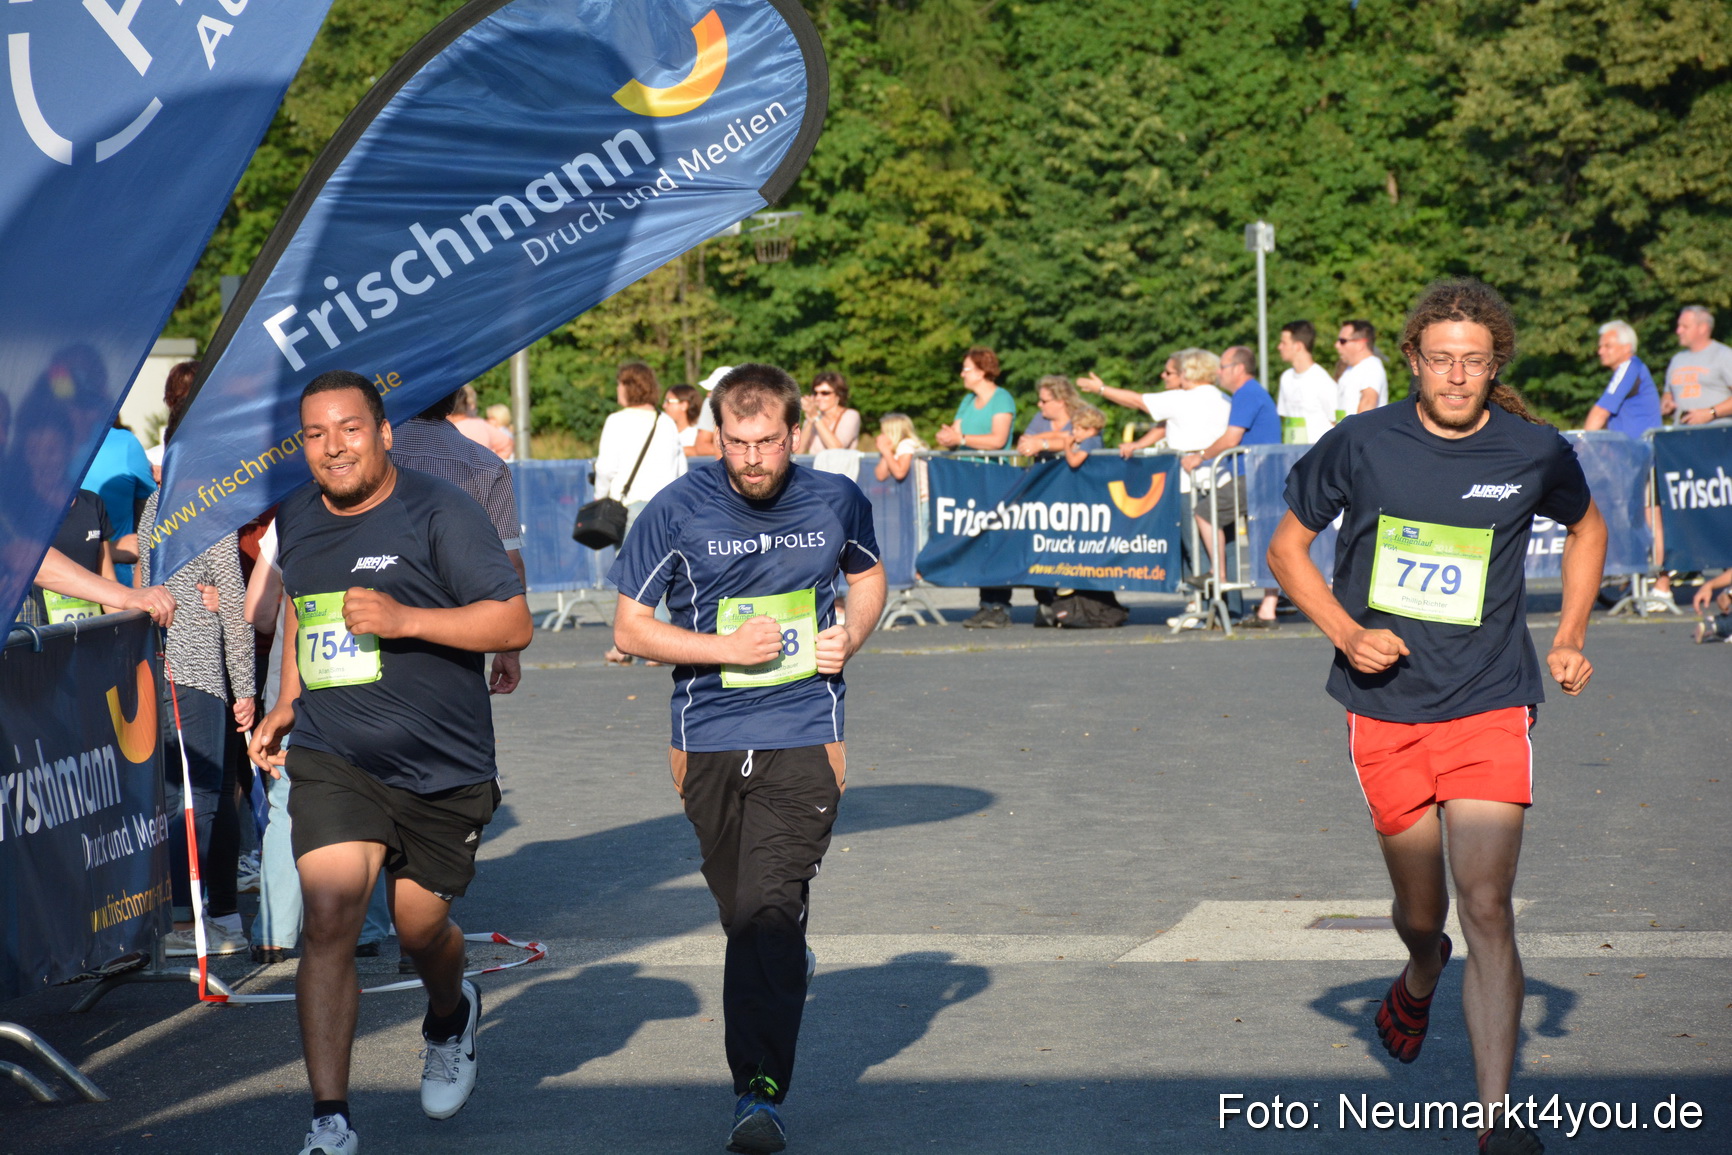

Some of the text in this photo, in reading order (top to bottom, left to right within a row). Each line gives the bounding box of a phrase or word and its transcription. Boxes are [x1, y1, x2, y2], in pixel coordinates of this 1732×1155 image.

[520, 101, 788, 267] Druck und Medien
[262, 128, 656, 372] Frischmann
[936, 496, 1112, 537] Frischmann
[707, 531, 826, 556] EURO POLES
[1033, 534, 1168, 554] Druck und Medien
[1028, 562, 1166, 581] www.frischmann-net.de
[1397, 557, 1462, 595] 779
[1401, 595, 1423, 606] Phillip
[1422, 597, 1448, 609] Richter
[306, 631, 359, 662] 754
[81, 824, 109, 871] Druck
[106, 816, 134, 861] und
